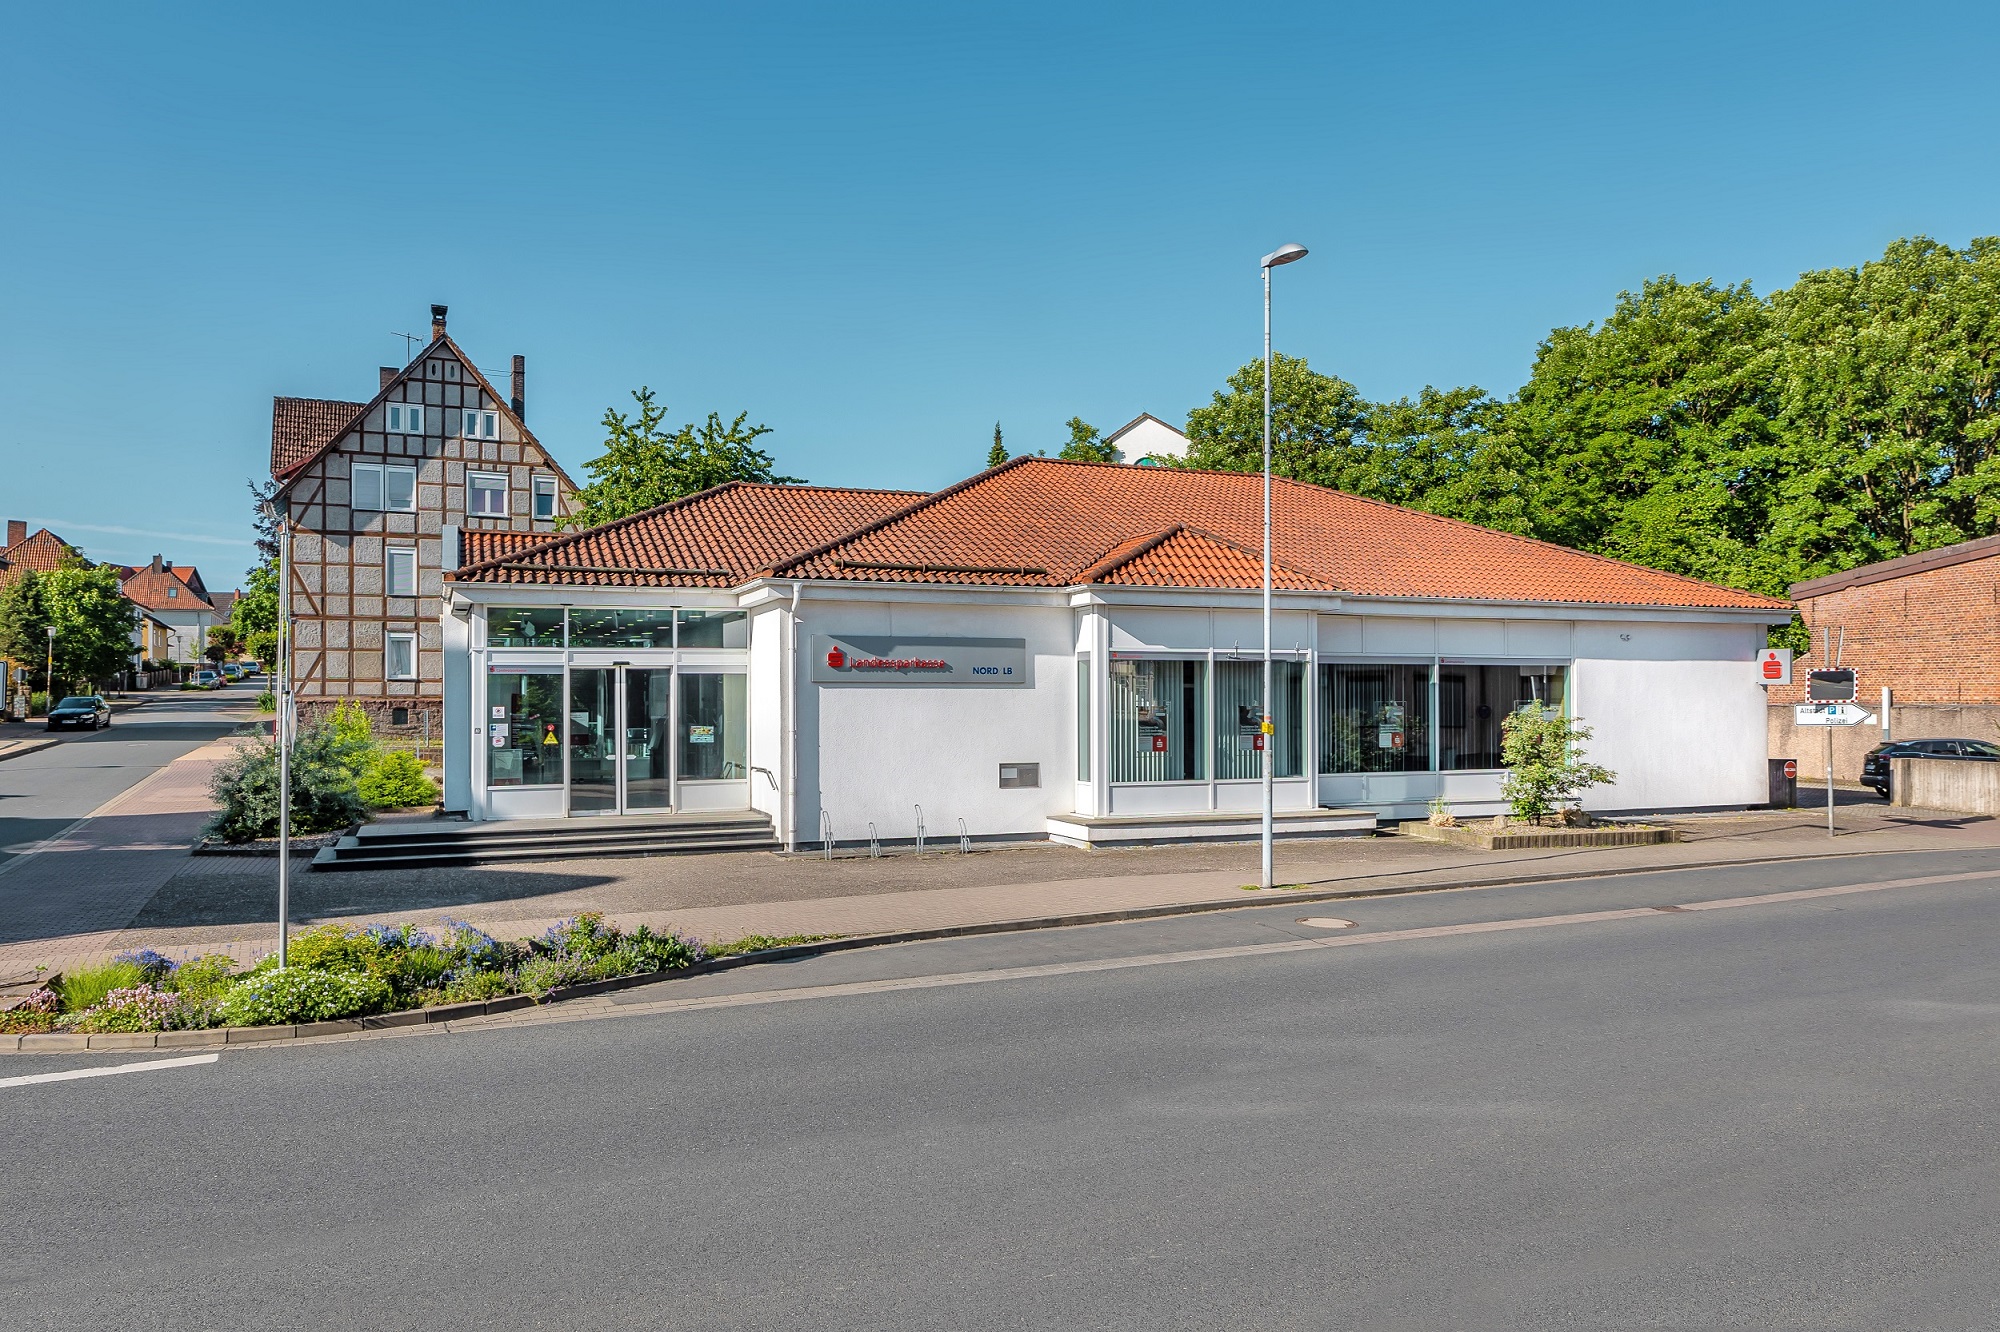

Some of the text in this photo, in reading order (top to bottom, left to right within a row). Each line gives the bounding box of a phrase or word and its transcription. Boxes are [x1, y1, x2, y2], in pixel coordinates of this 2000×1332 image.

[849, 656, 945, 670] Landessparkasse
[972, 667, 1012, 675] NORD LB
